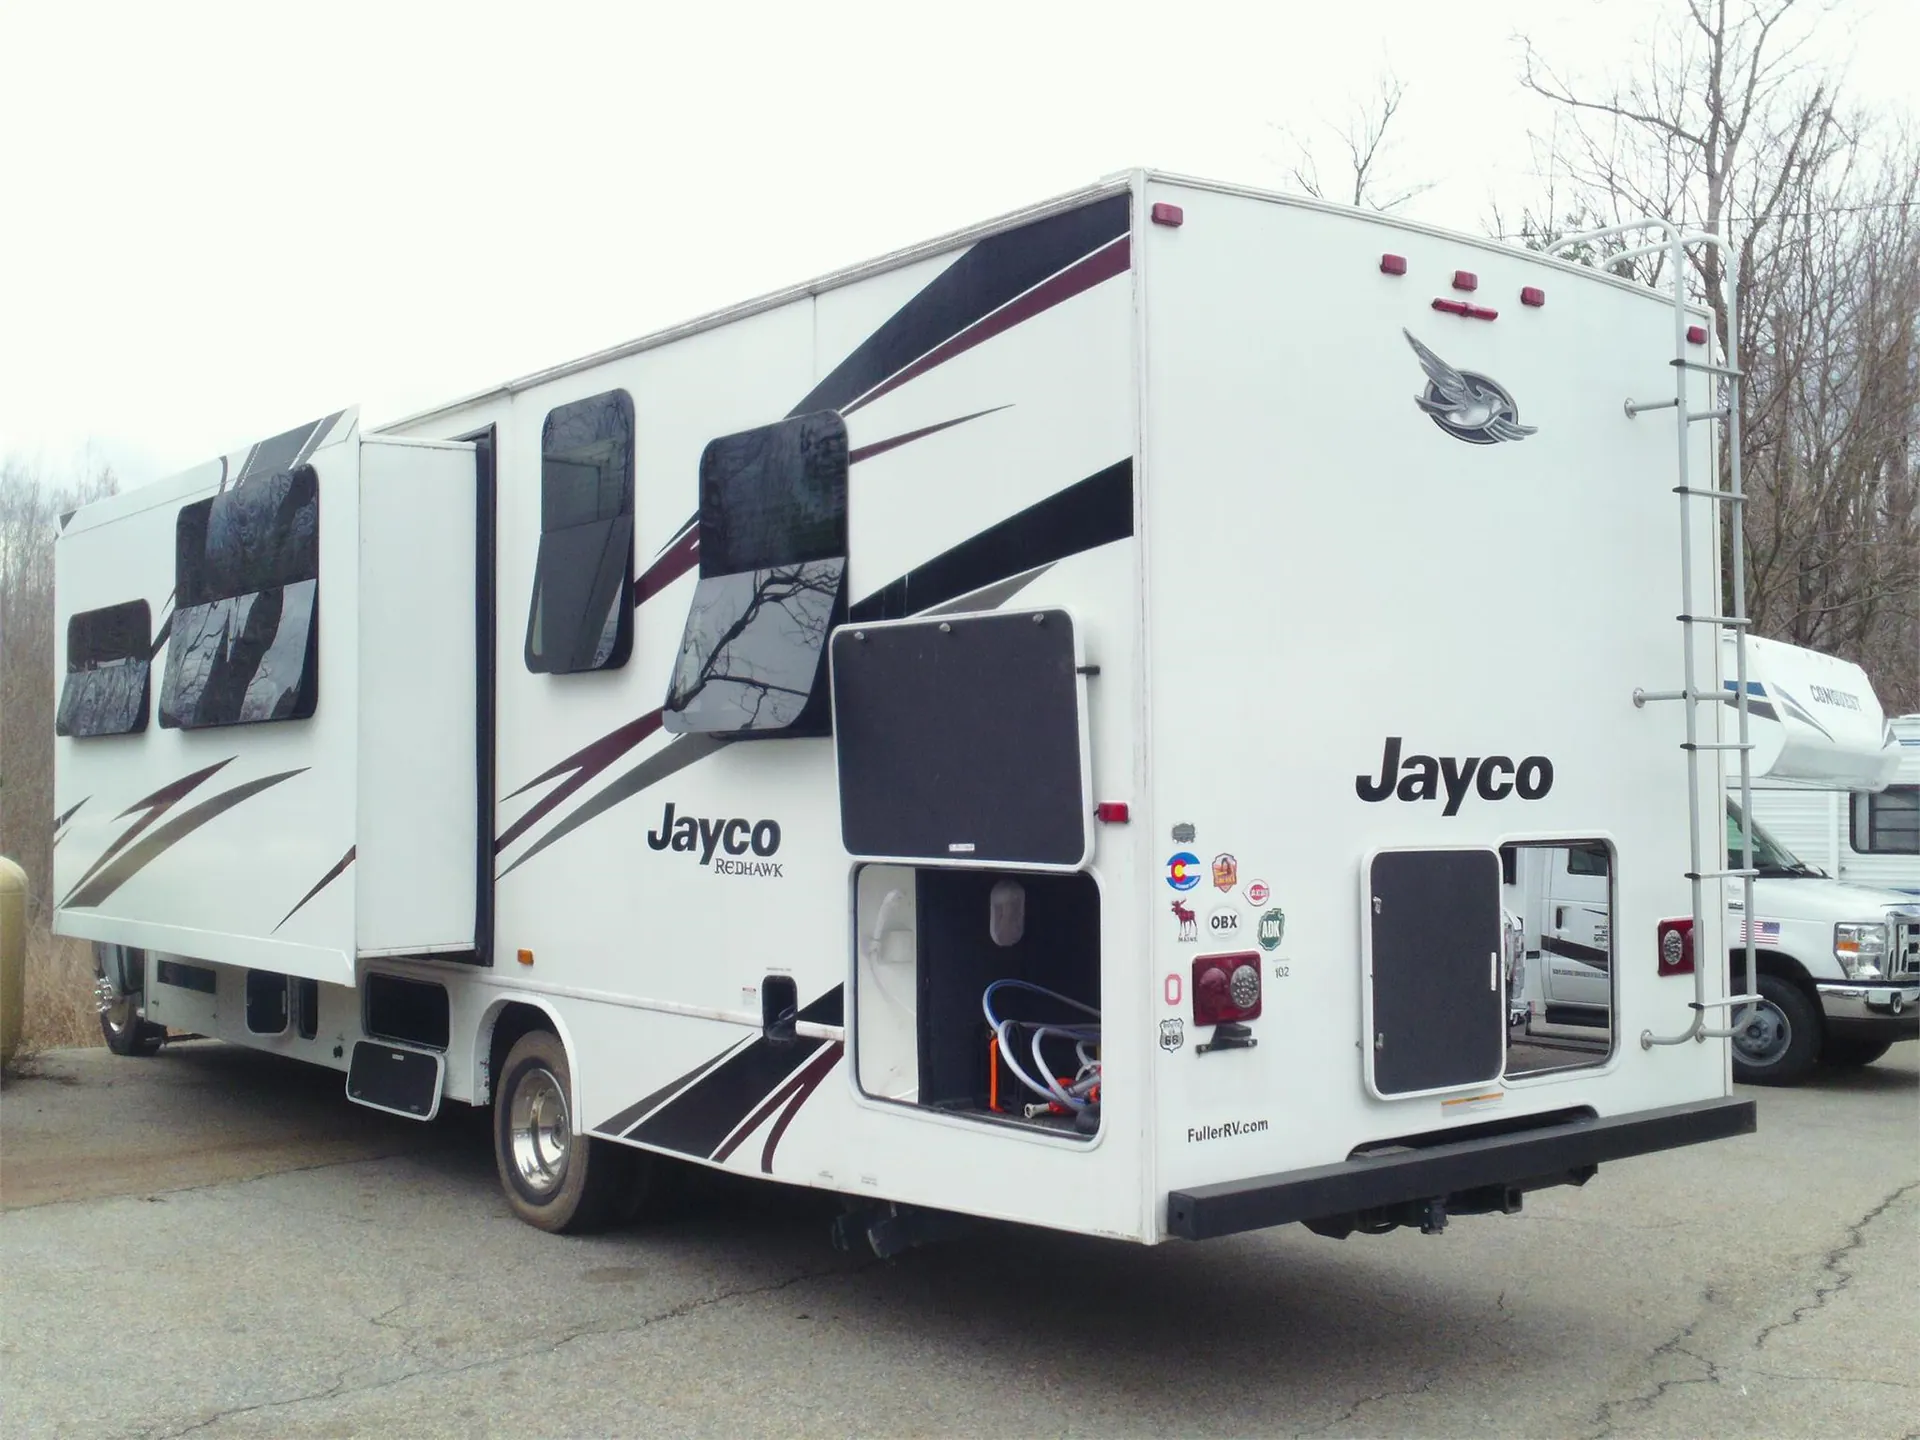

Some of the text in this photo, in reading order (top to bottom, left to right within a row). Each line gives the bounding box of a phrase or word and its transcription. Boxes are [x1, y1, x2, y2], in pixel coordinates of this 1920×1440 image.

[1355, 736, 1554, 817] Jayco
[647, 802, 782, 865] Jayco
[714, 858, 784, 878] REDHAWK
[1211, 915, 1238, 930] OBX
[1262, 920, 1280, 938] ADK
[1164, 1034, 1179, 1046] 66
[1187, 1119, 1268, 1142] FullerRV.com
